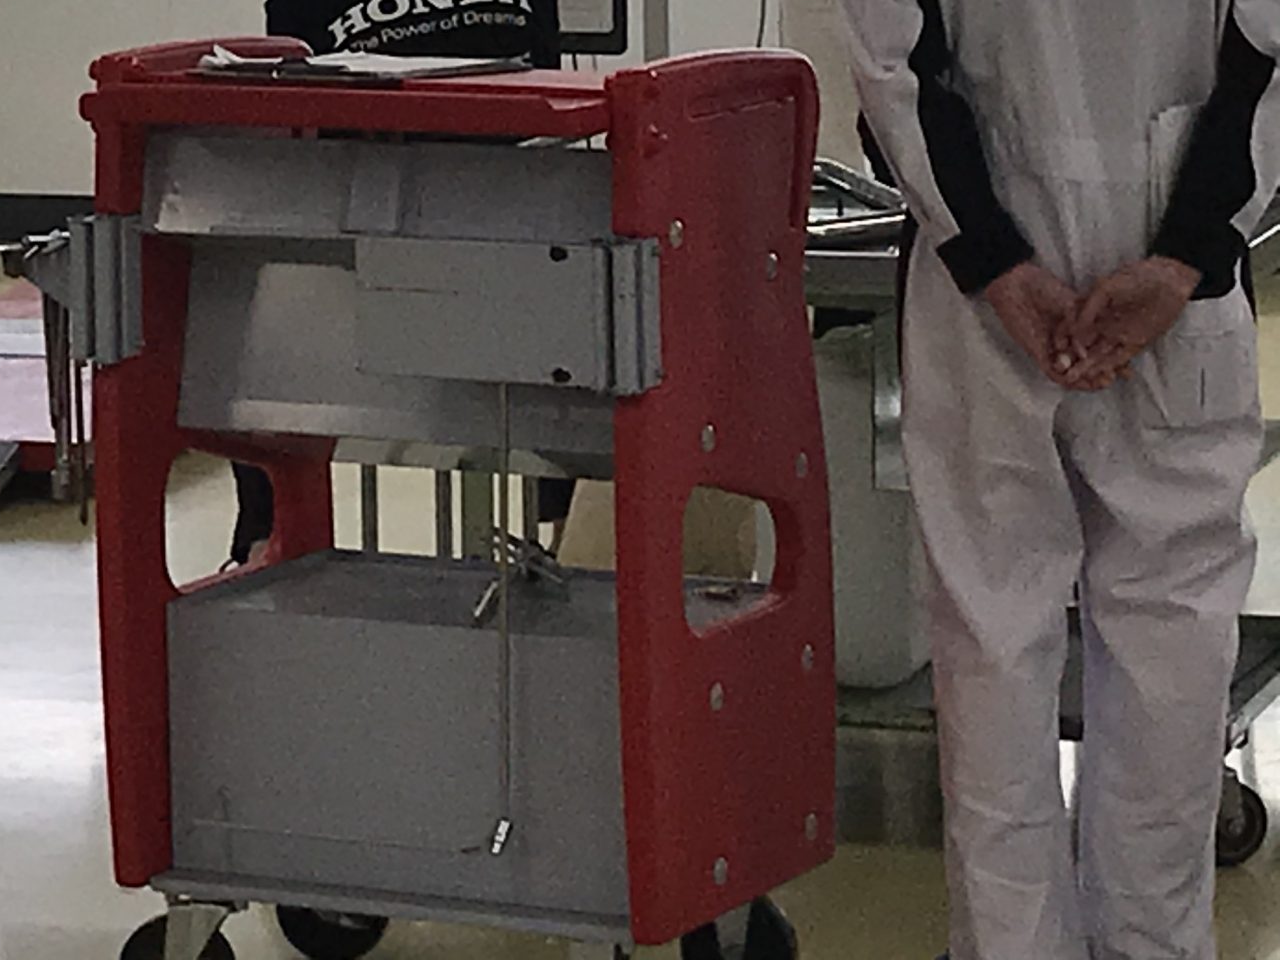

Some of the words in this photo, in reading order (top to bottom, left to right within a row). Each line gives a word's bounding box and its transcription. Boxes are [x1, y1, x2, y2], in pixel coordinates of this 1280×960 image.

[380, 20, 438, 44] Power
[439, 12, 461, 31] of
[463, 10, 528, 27] Dreams
